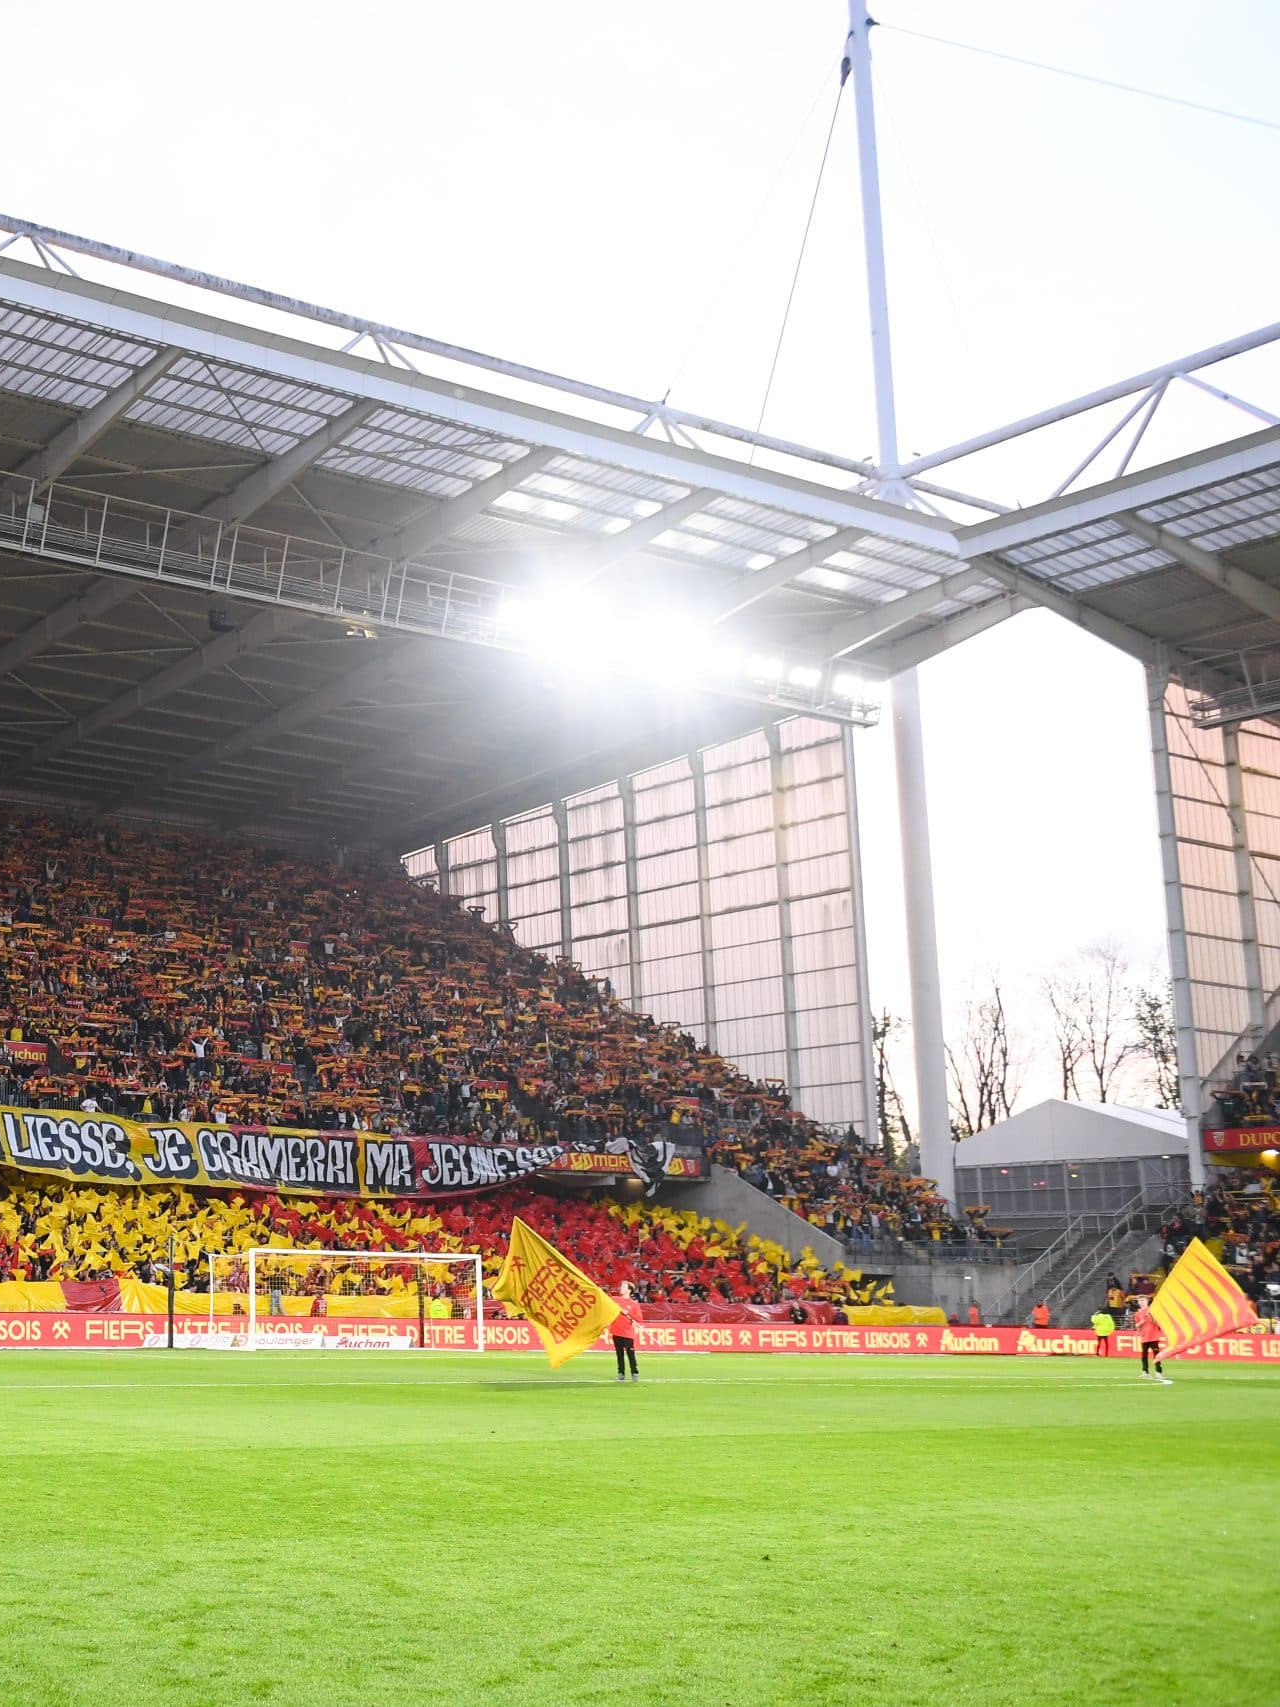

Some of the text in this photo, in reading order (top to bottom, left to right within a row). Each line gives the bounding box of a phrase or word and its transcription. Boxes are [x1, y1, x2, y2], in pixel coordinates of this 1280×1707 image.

[143, 1128, 191, 1172] JE
[197, 1129, 354, 1185] CRAMERAI
[365, 1142, 413, 1187] MA
[551, 1289, 597, 1345] LENSOIS
[85, 1318, 154, 1340] FIERS
[682, 1328, 733, 1347] LENSOIS
[758, 1328, 911, 1349] FIERS D'ÊTRE LENSOIS
[940, 1329, 999, 1351] Auchan
